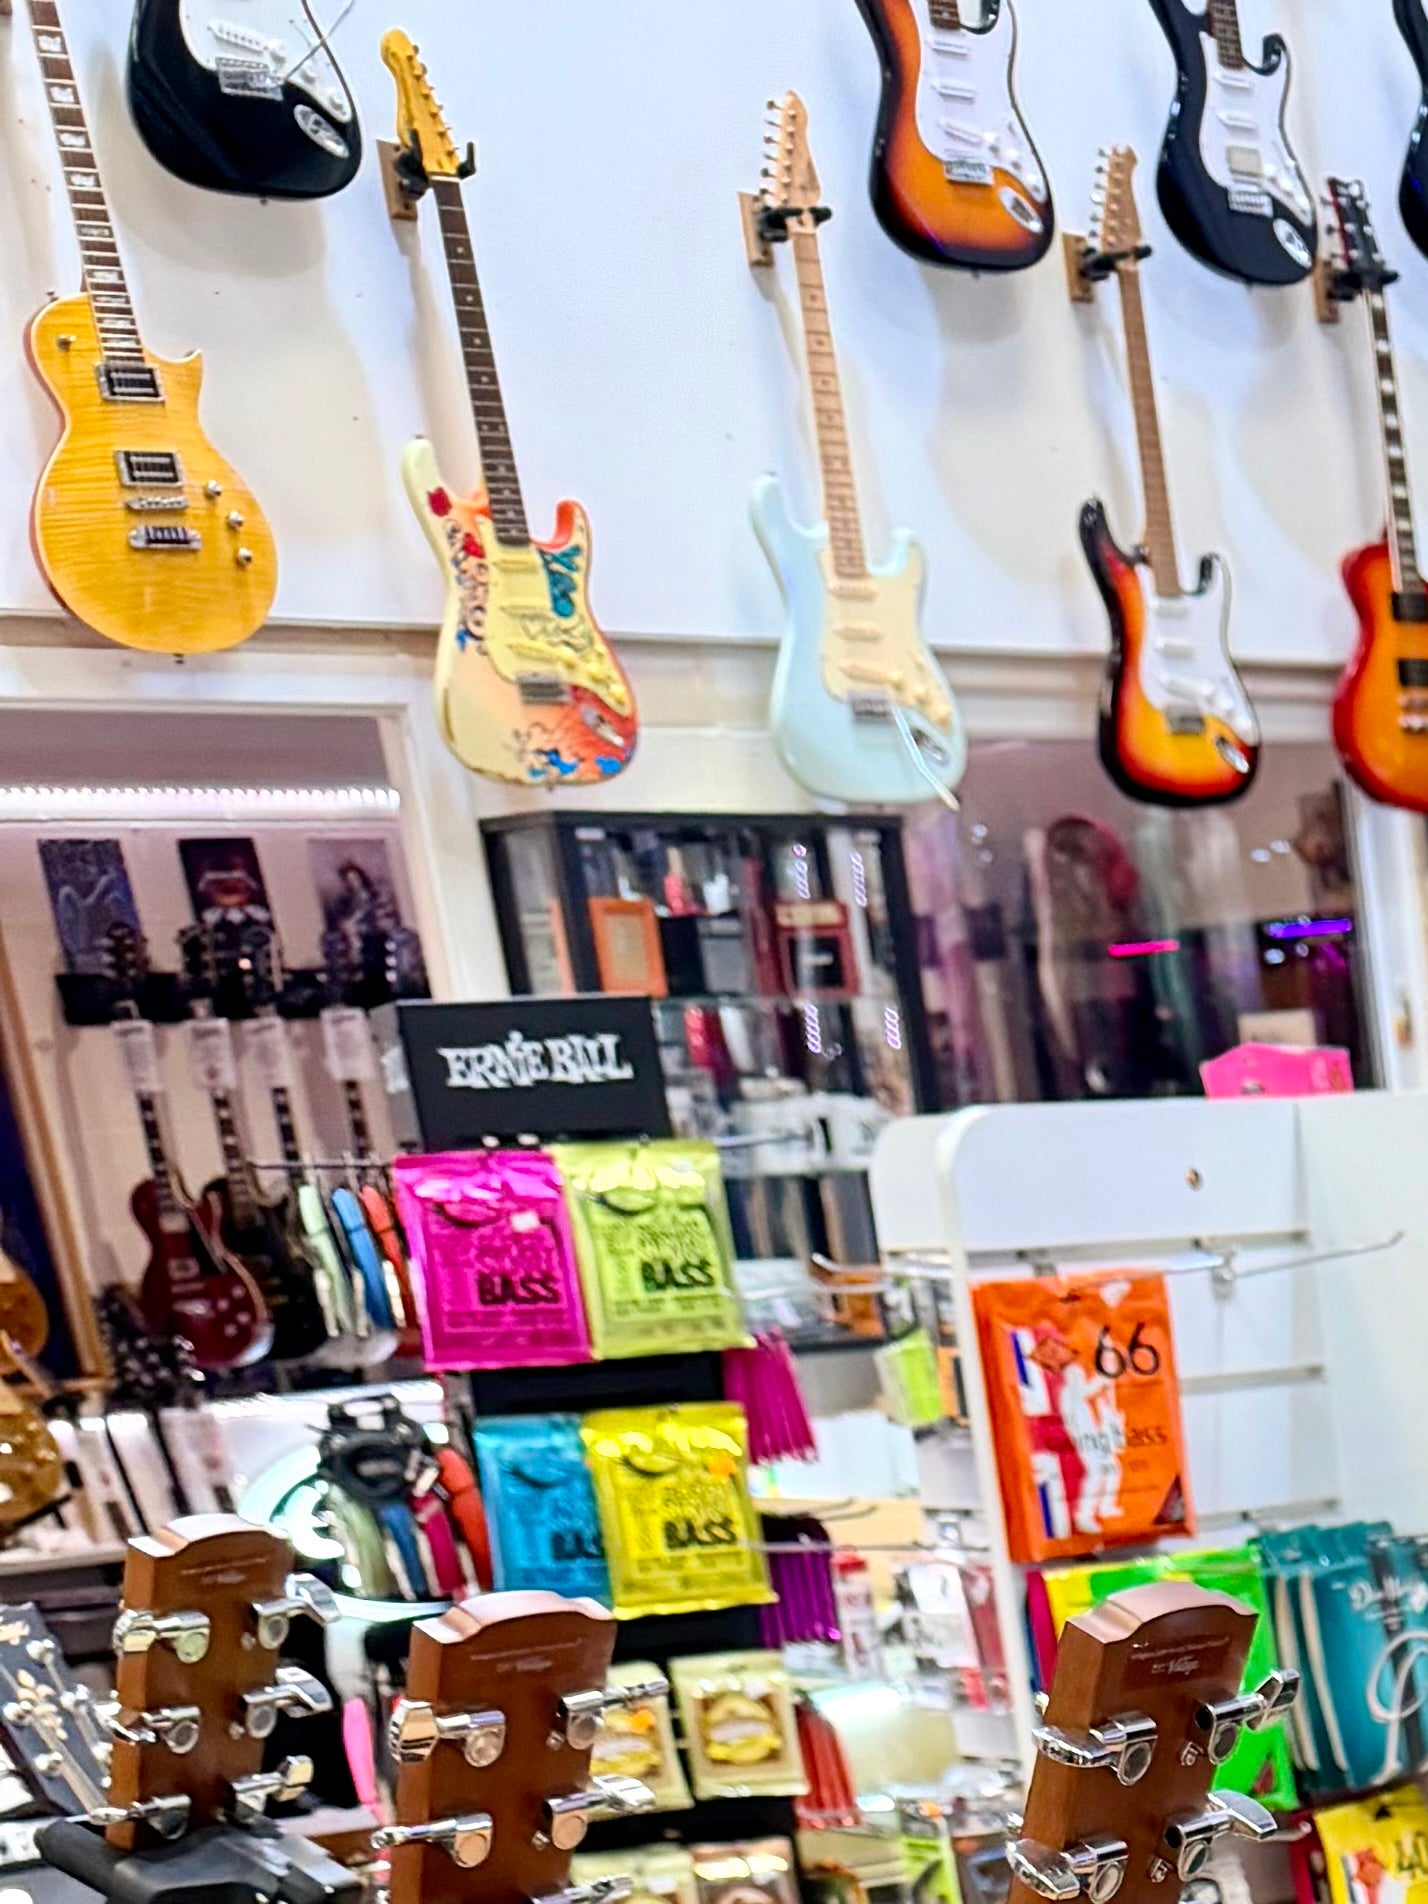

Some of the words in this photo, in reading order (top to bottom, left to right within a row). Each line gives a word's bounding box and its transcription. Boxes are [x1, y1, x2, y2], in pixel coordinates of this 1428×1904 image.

[438, 1030, 551, 1090] ERNIE
[545, 1032, 635, 1084] BALL
[477, 1272, 561, 1306] BASS
[641, 1258, 715, 1292] BASS
[1094, 1322, 1160, 1379] 66
[551, 1528, 606, 1561] BAS
[663, 1517, 737, 1550] BASS
